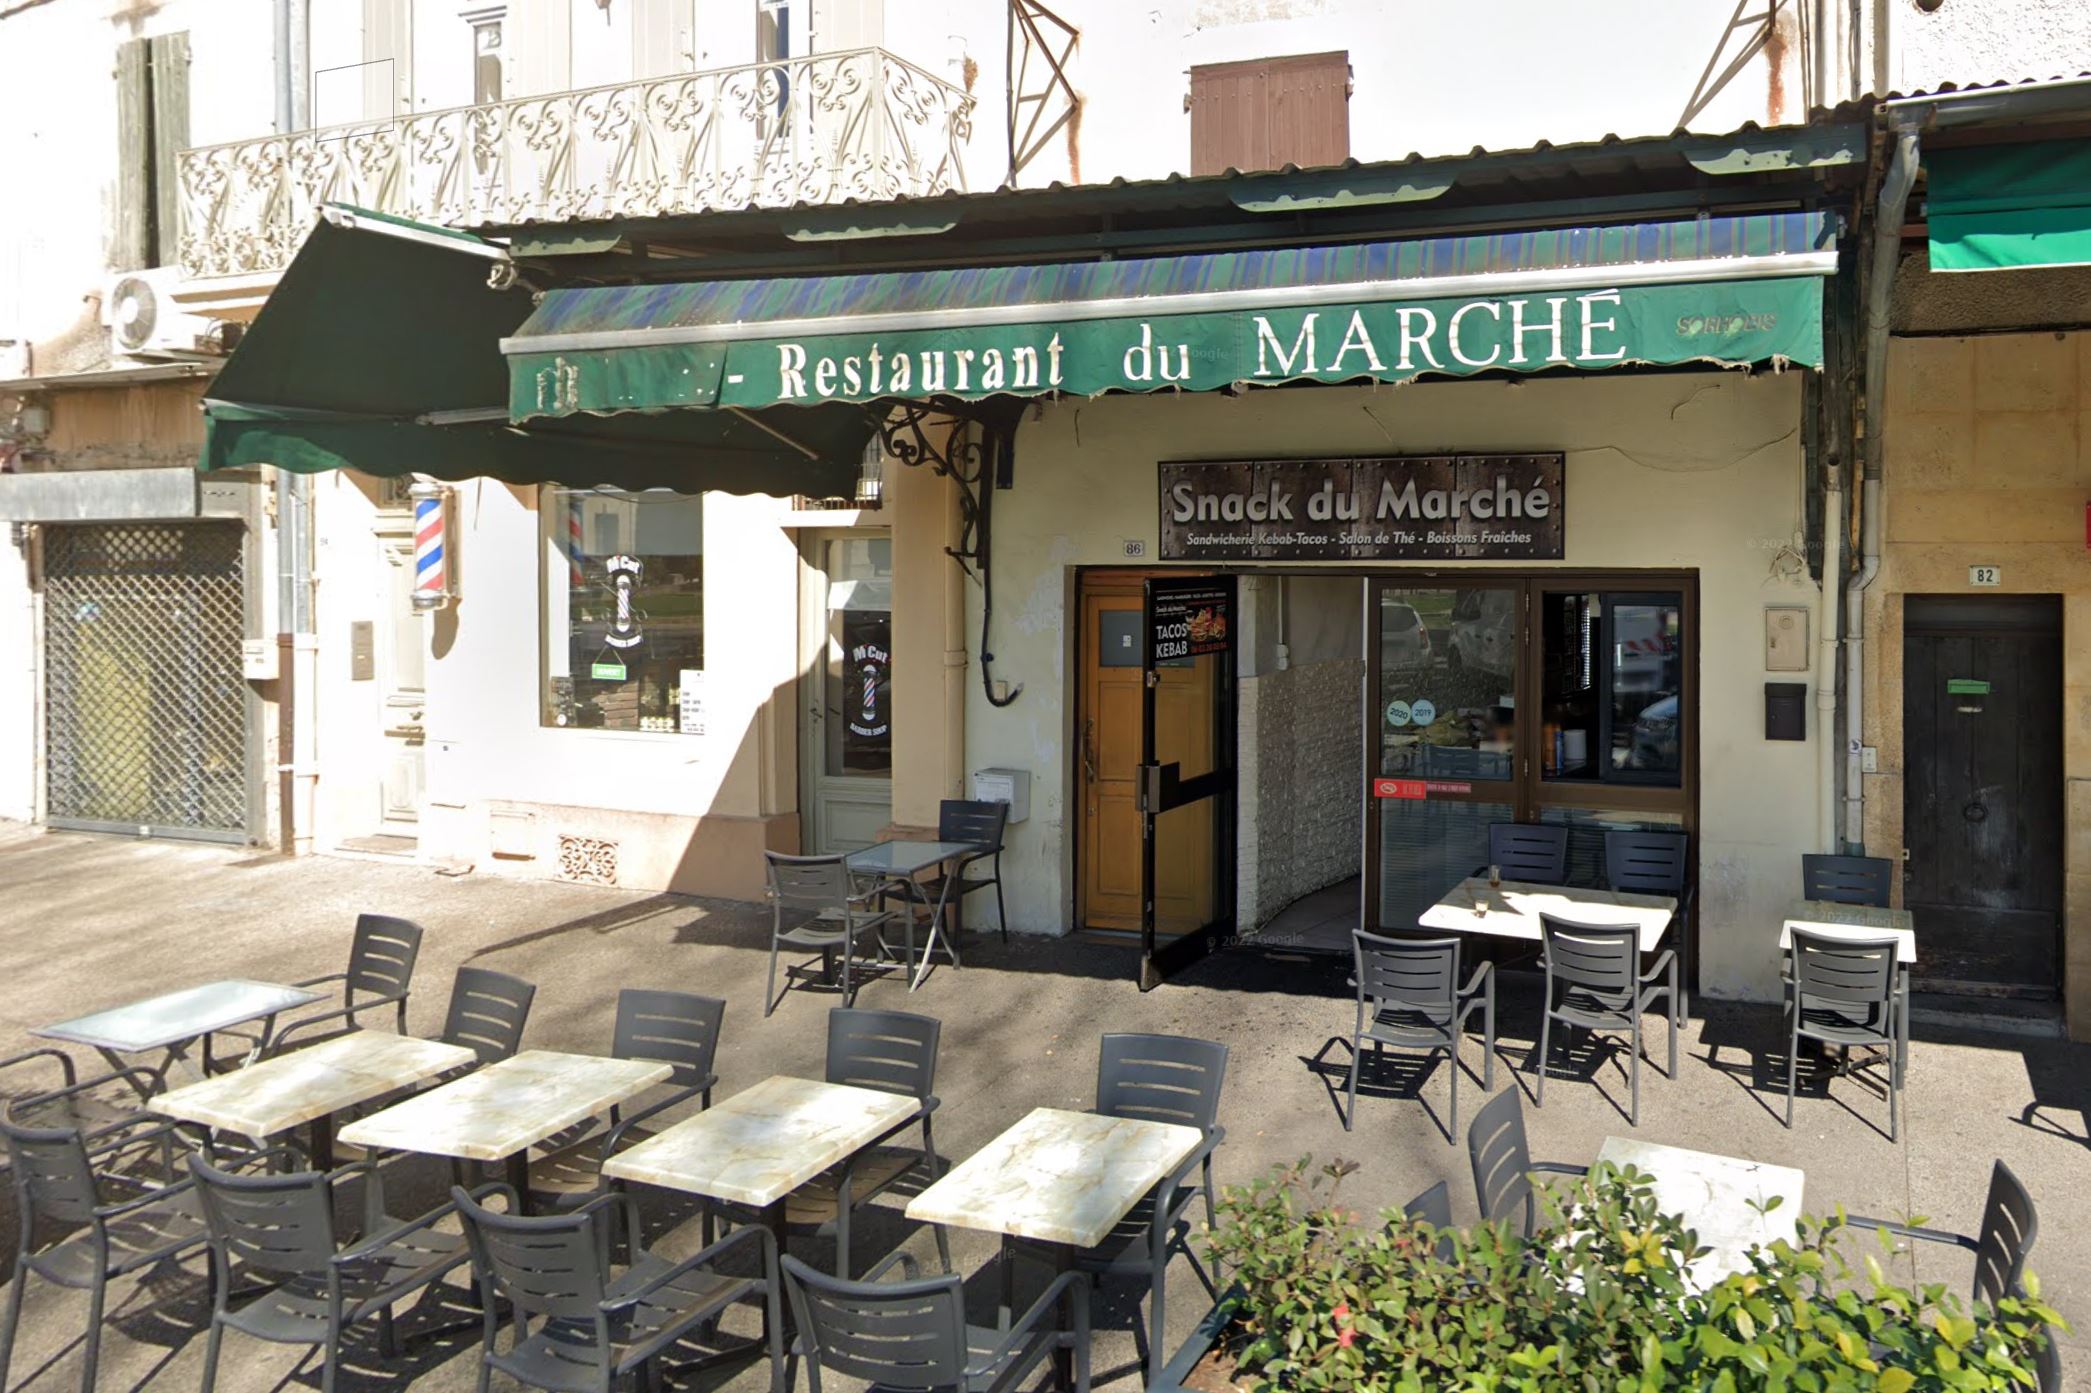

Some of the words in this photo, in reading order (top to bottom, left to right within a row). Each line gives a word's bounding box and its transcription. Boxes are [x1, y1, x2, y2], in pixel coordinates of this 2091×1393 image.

[776, 332, 1065, 399] Restaurant
[1122, 323, 1192, 382] du
[1252, 287, 1627, 378] MARCHÉ
[1171, 479, 1294, 523] Snack
[1307, 478, 1360, 521] du
[1376, 474, 1550, 520] Marché
[1186, 532, 1256, 546] Sandwicherie
[1258, 532, 1328, 546] Kebab-Tacos
[1339, 531, 1373, 545] Salon
[1375, 532, 1390, 545] de
[1393, 531, 1415, 545] Thé
[1427, 531, 1478, 545] Boissons
[1481, 530, 1532, 544] Fraîches
[1125, 543, 1141, 555] 86
[1976, 569, 1993, 583] 82
[1156, 623, 1187, 640] TACOS
[1156, 641, 1187, 658] KEBAB
[1390, 707, 1409, 720] 2020
[1415, 708, 1431, 717] 2019
